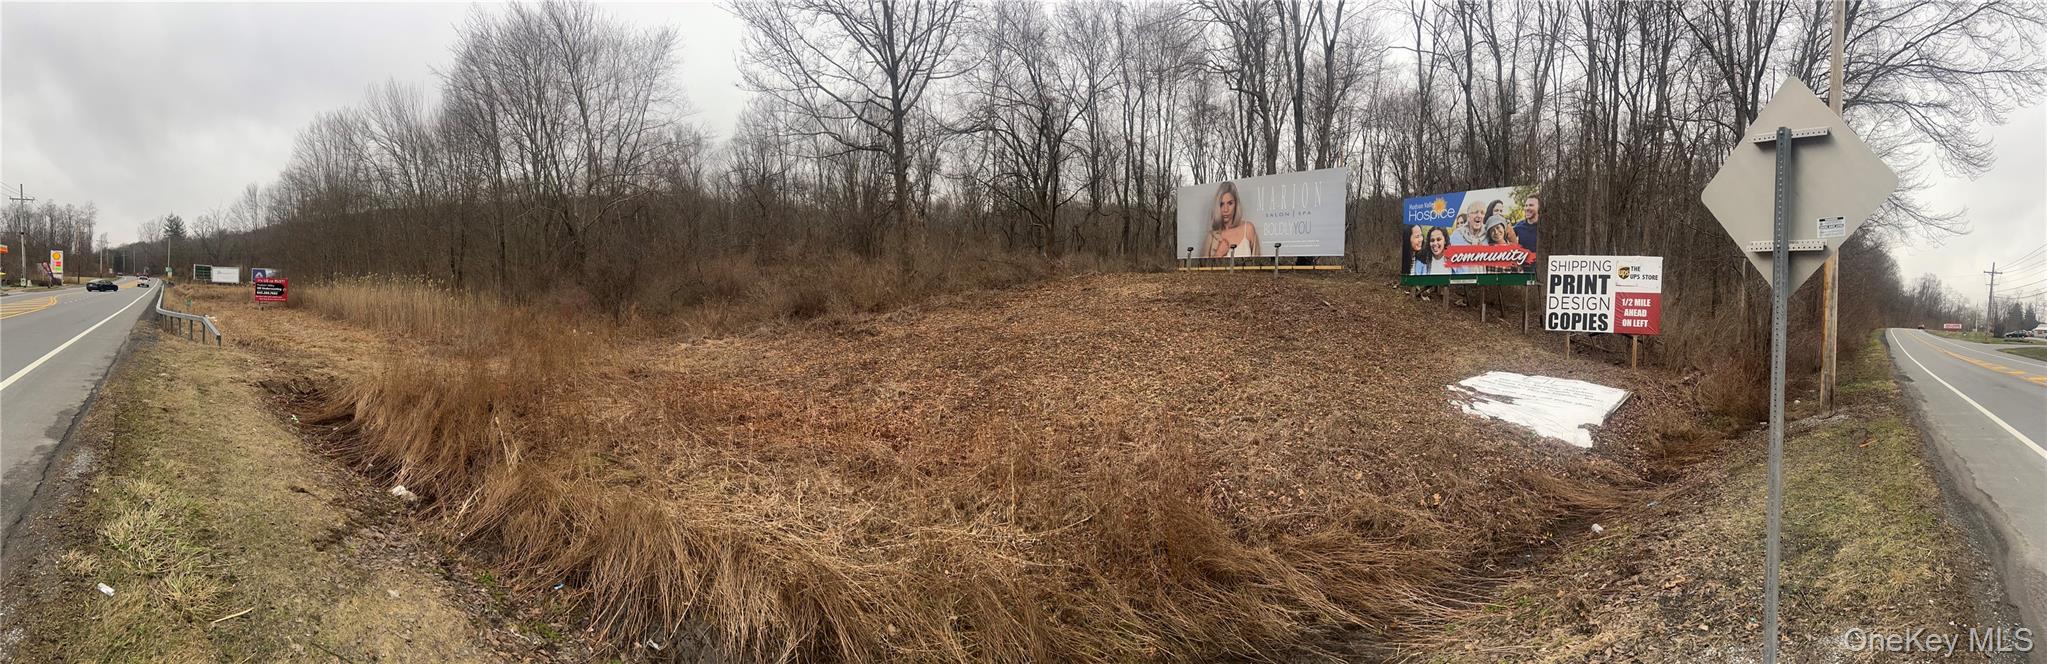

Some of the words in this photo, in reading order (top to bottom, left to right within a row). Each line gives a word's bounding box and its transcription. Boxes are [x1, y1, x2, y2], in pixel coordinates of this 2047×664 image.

[1257, 181, 1322, 211] MARION
[1409, 208, 1455, 222] Hospice
[1450, 249, 1528, 265] community
[1550, 260, 1612, 272] SHIPPING
[1549, 274, 1611, 295] PRINT
[1548, 296, 1610, 311] DESIGN
[1622, 298, 1633, 307] 1/2
[1634, 298, 1651, 307] MILE
[1624, 309, 1647, 317] AHEAD
[1548, 312, 1609, 331] COPIES
[1622, 319, 1633, 328] ON
[1633, 319, 1649, 328] LEFT
